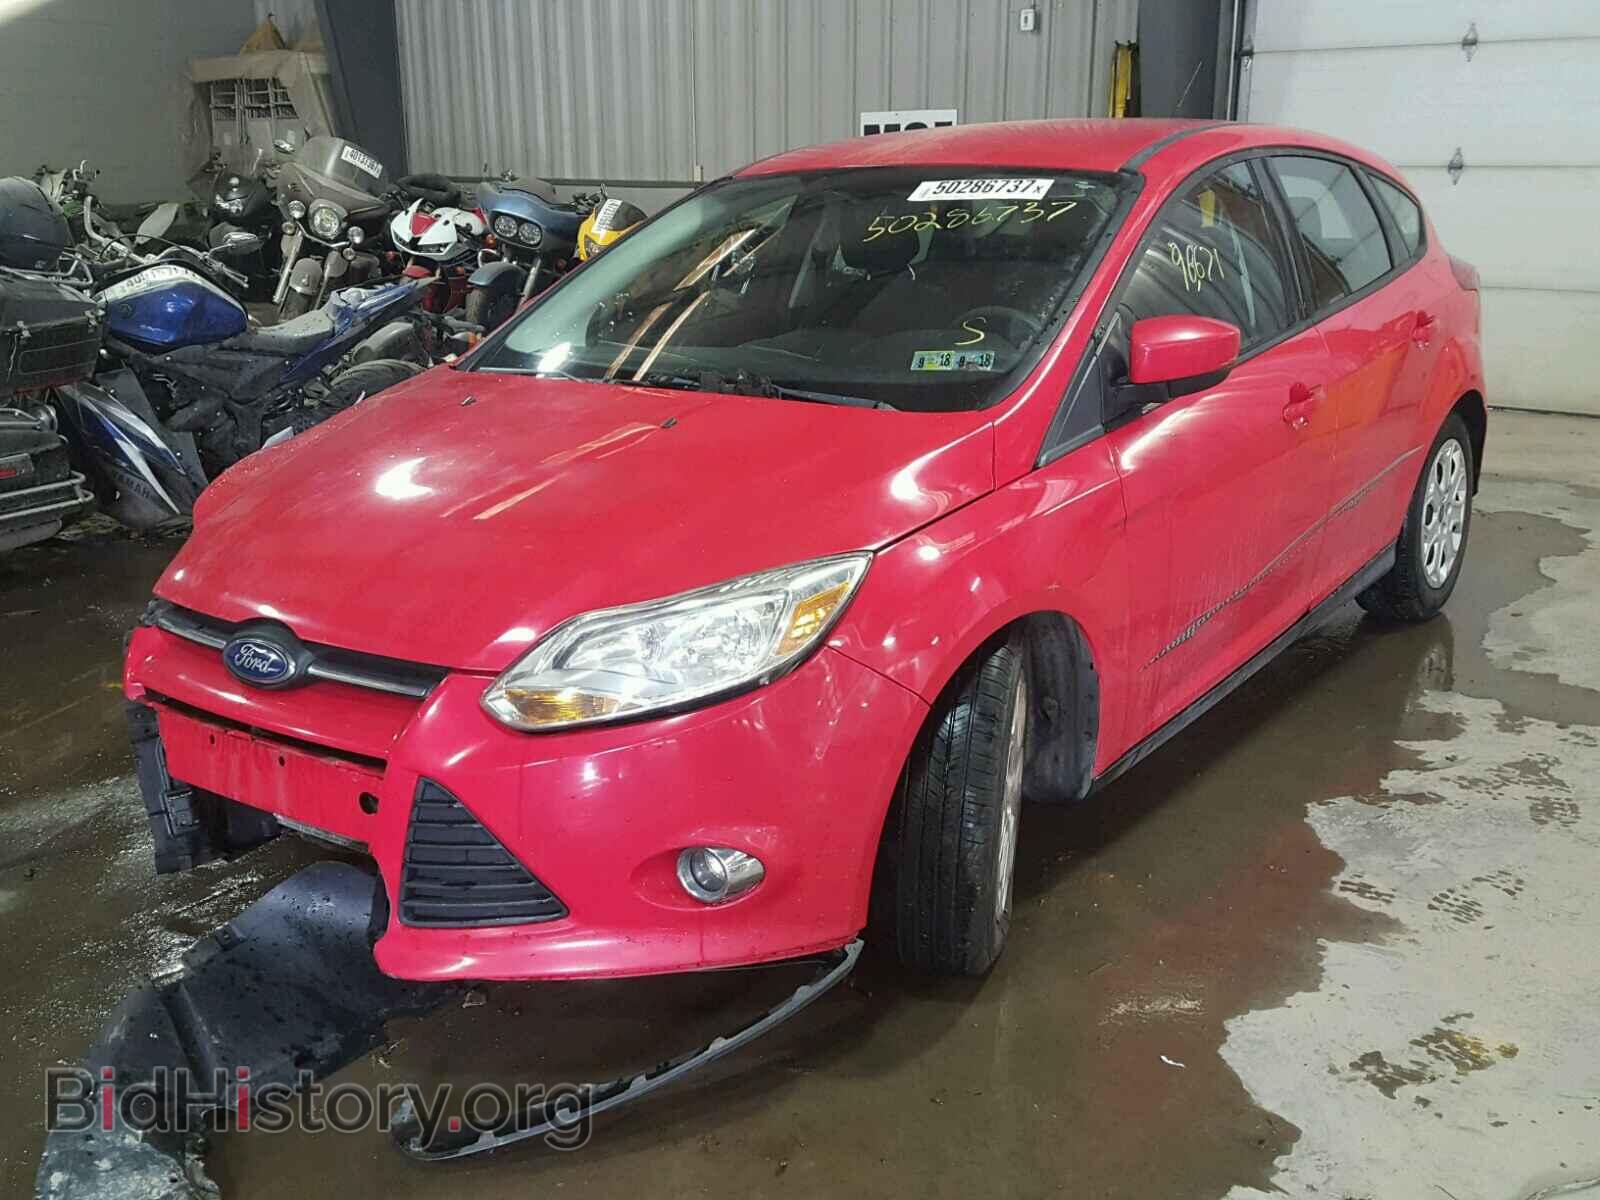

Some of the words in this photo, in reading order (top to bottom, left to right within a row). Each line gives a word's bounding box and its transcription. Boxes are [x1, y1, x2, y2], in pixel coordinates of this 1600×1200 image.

[933, 180, 1036, 195] 50286737
[863, 201, 1077, 242] 50286737
[233, 642, 282, 674] Ford
